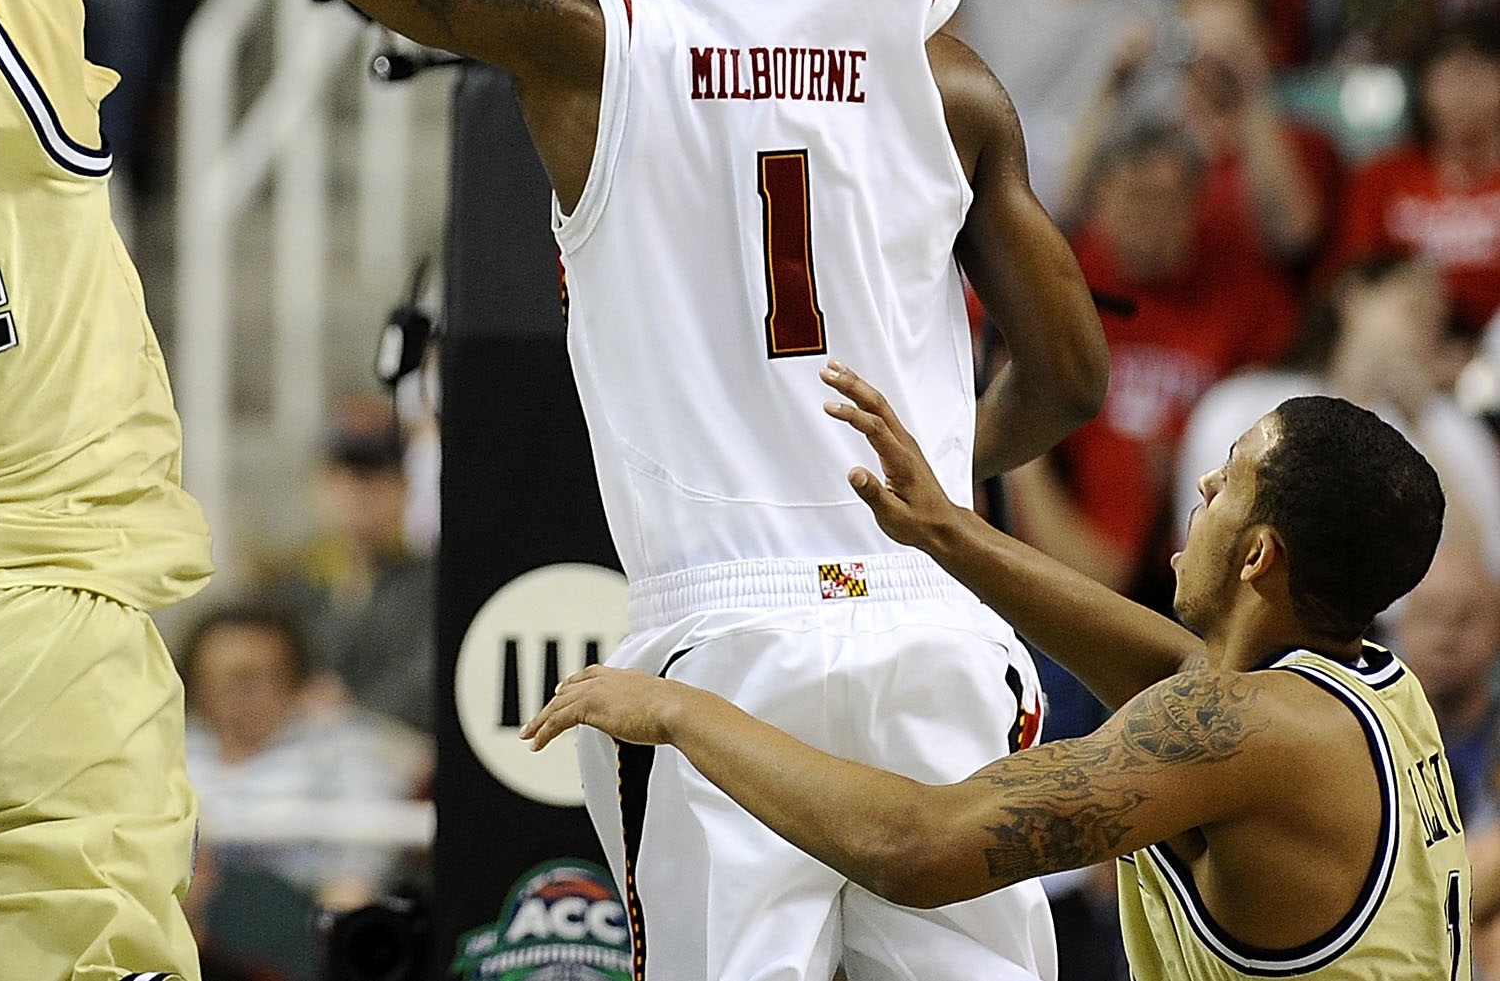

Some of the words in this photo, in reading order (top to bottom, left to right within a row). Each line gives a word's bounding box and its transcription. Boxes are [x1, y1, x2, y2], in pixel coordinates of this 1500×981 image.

[690, 46, 867, 104] MILBOURNE
[756, 148, 828, 360] 1
[503, 896, 629, 945] ACC
